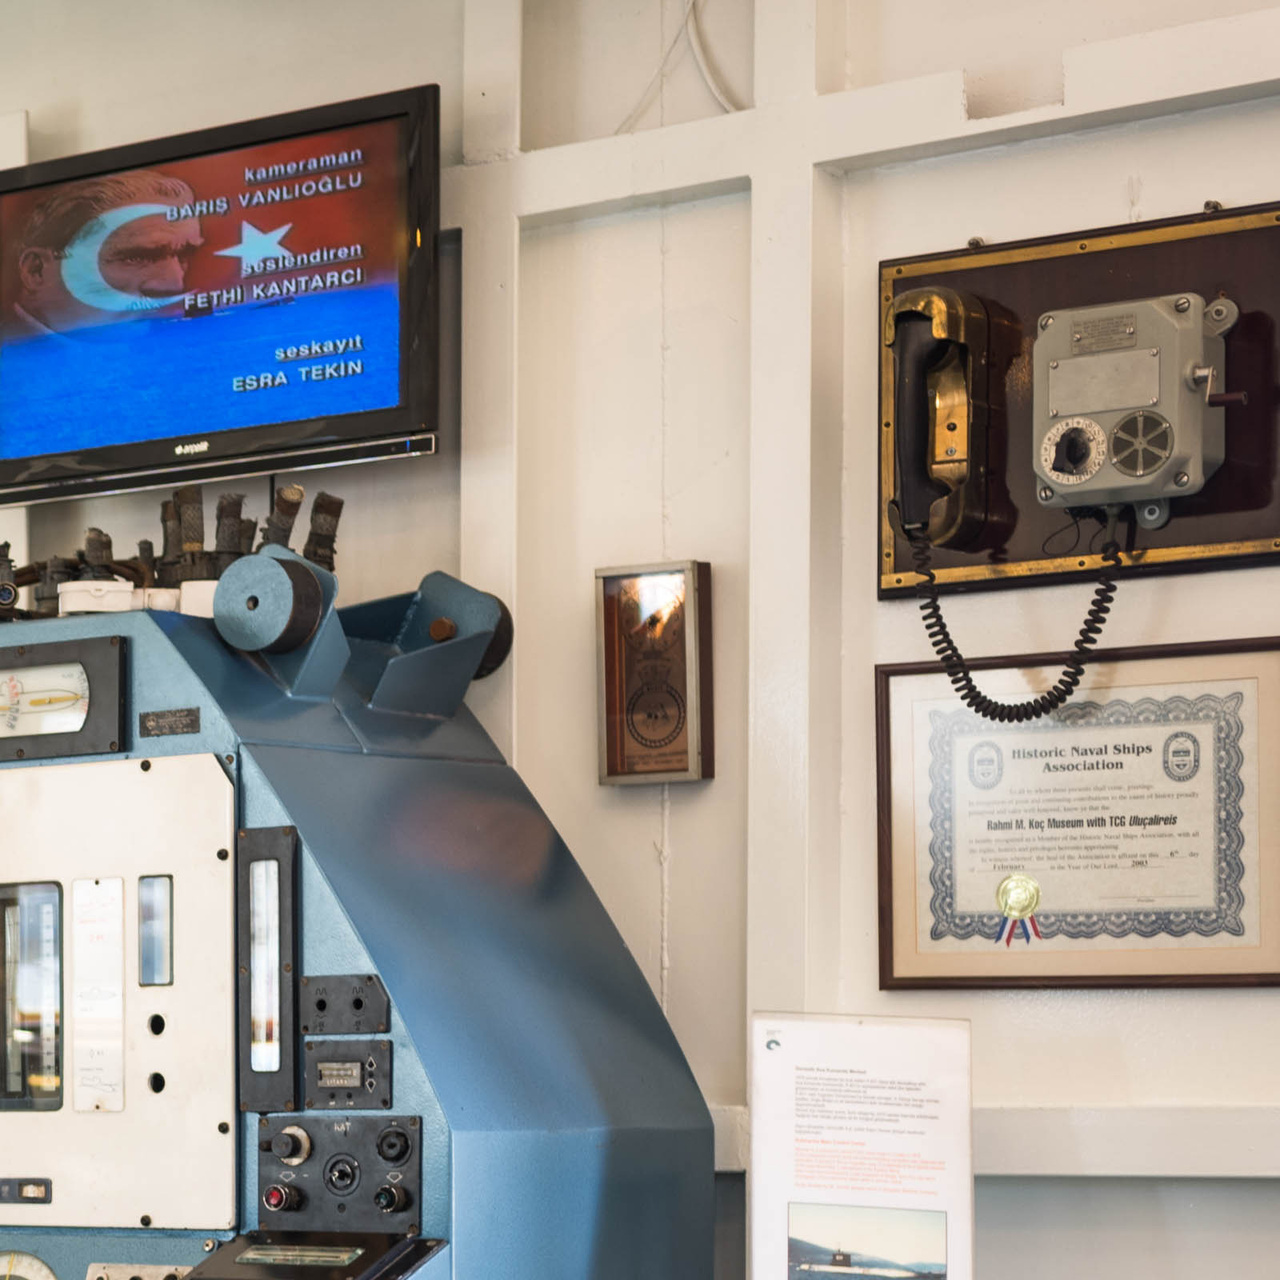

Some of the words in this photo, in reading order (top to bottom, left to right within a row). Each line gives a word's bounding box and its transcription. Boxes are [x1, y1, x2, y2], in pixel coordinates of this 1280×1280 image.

[244, 149, 362, 182] kameraman
[166, 197, 229, 221] BARIŞ
[238, 172, 362, 207] VANLIOĞLU
[242, 244, 362, 276] seslendiren
[233, 371, 288, 392] ESRA
[1012, 746, 1066, 760] Historic
[1071, 744, 1108, 757] Naval
[1113, 743, 1153, 757] Ships
[1043, 760, 1124, 773] Association
[987, 819, 1013, 831] Rahmi
[1015, 819, 1025, 830] M.
[1029, 818, 1045, 832] Koç
[1047, 817, 1084, 829] Museum
[1087, 816, 1106, 828] with
[1109, 815, 1126, 827] TCG
[1129, 813, 1178, 829] Uluçalireis
